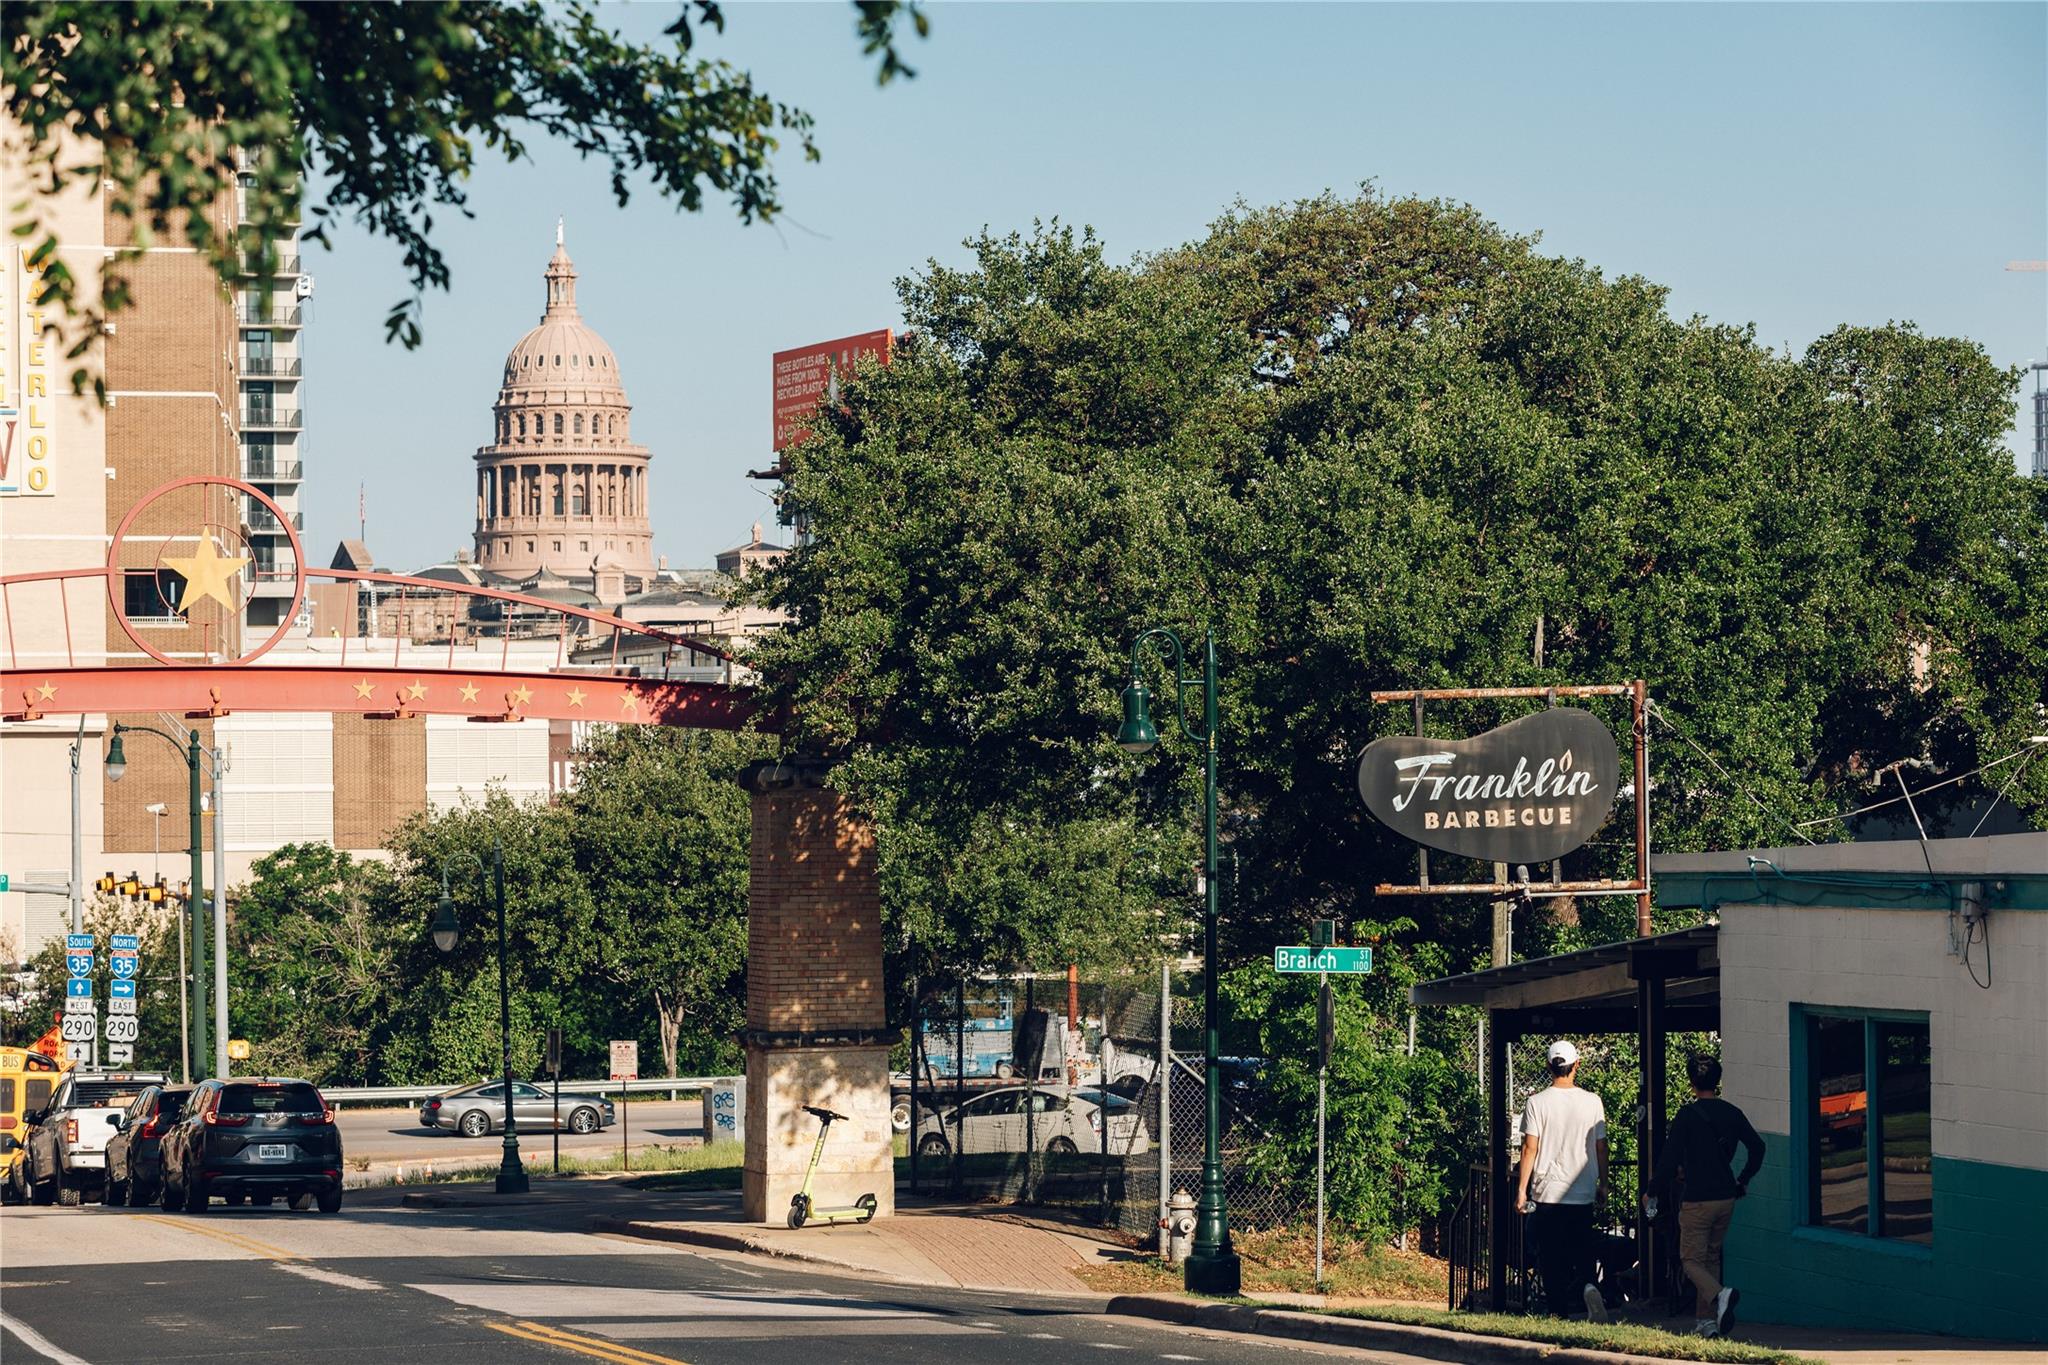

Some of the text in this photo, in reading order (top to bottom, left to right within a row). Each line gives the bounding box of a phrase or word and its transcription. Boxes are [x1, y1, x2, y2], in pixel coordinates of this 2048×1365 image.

[22, 248, 48, 492] WATERLOO
[777, 353, 825, 374] THESE BOTTLES ARE
[777, 374, 792, 388] MADE
[792, 371, 807, 385] FROM
[777, 380, 824, 401] RECYCLED PLASTIC
[1392, 749, 1598, 812] Franklin
[1424, 807, 1572, 830] BARBECUE
[69, 936, 92, 947] SOUTH
[112, 936, 137, 948] NORTH
[71, 957, 90, 973] 35
[114, 959, 134, 975] 35
[1278, 950, 1369, 969] Branch ST
[1353, 961, 1369, 971] 1100
[70, 1001, 89, 1010] WEST
[113, 1001, 132, 1011] EAST
[64, 1020, 93, 1036] 290
[108, 1021, 136, 1037] 290
[44, 1039, 66, 1047] ROAD
[2, 1055, 19, 1068] BUS
[42, 1050, 65, 1058] WORK
